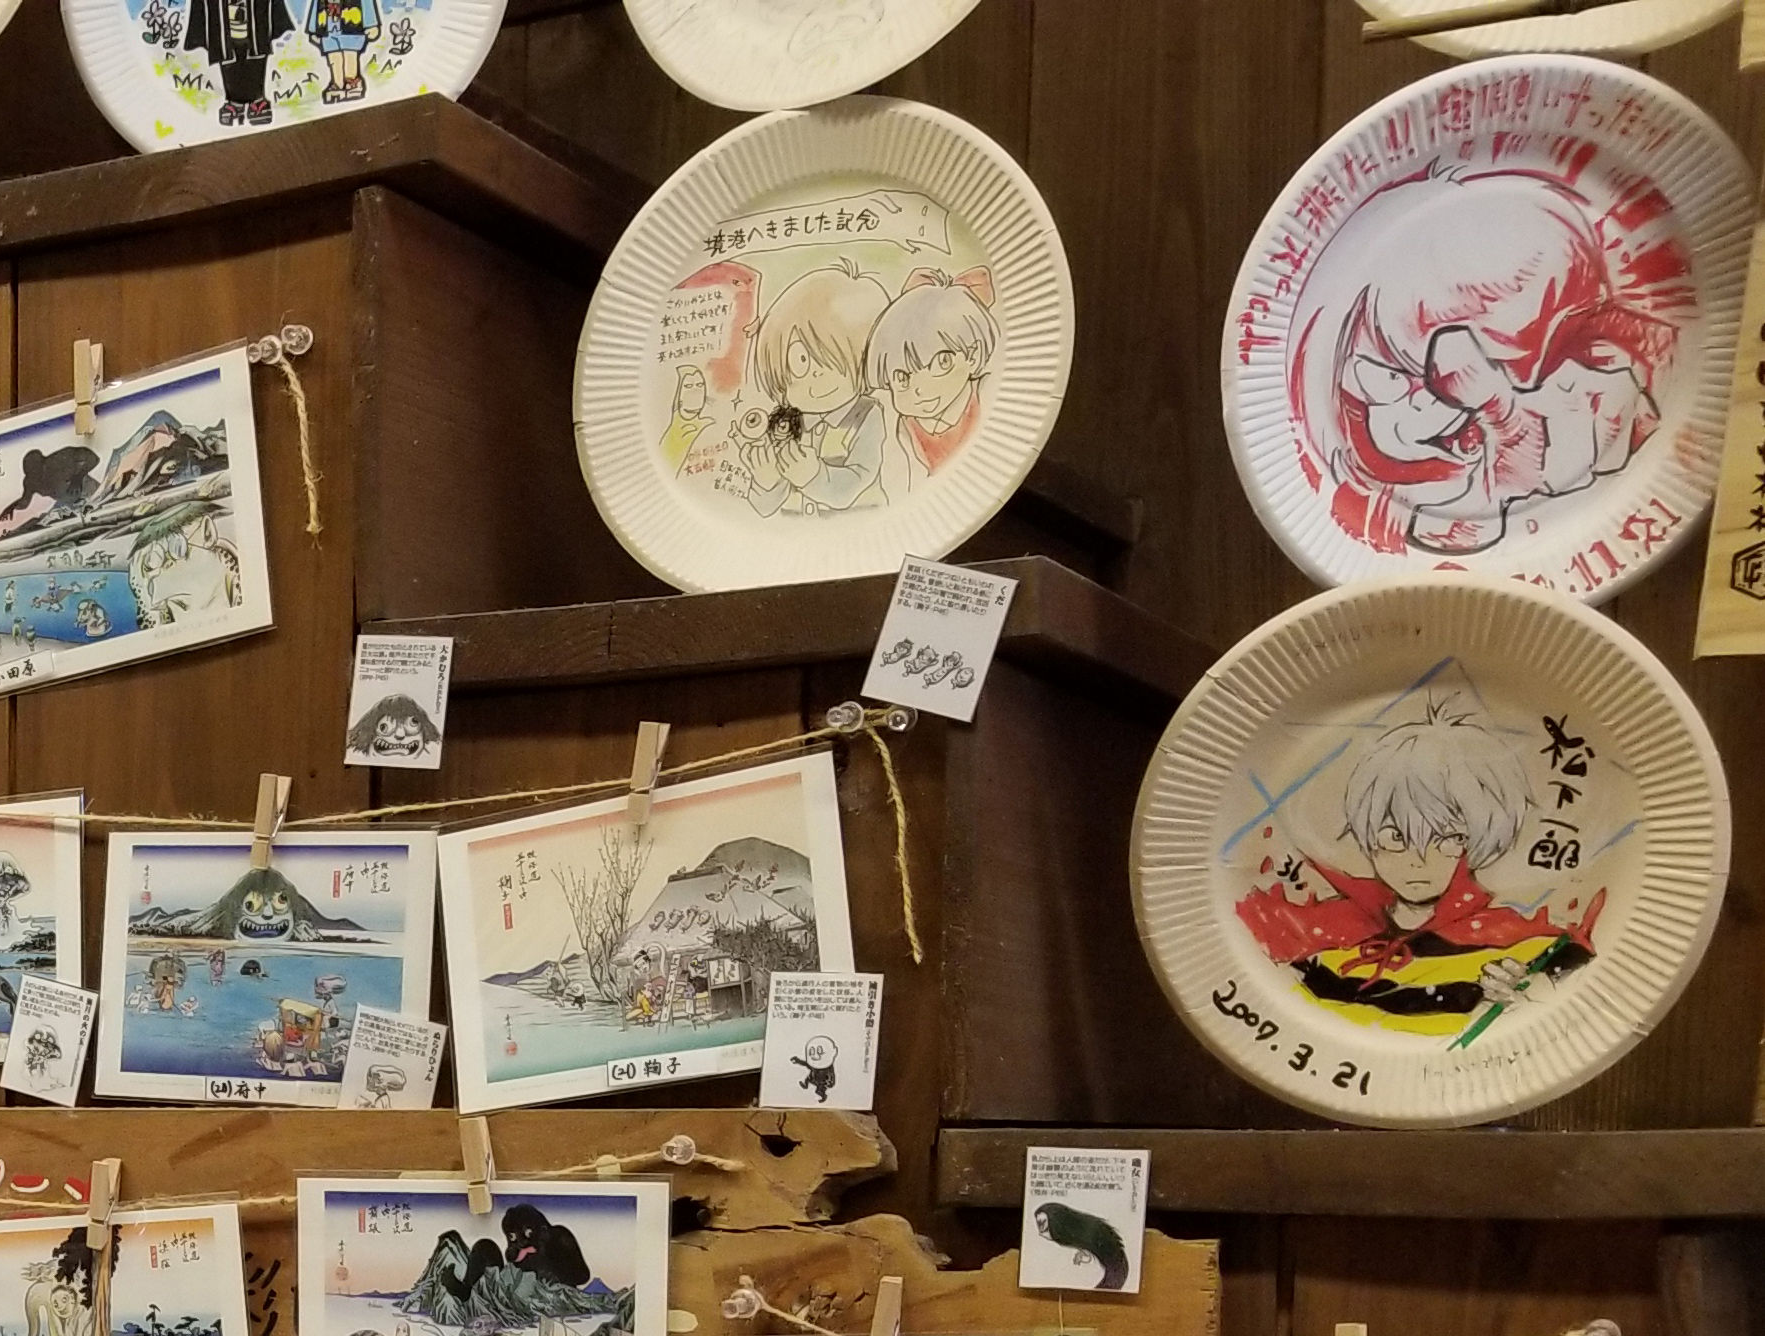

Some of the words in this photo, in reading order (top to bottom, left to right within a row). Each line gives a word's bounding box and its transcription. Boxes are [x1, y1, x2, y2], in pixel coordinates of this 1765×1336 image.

[704, 208, 881, 257] 境港へきました記念
